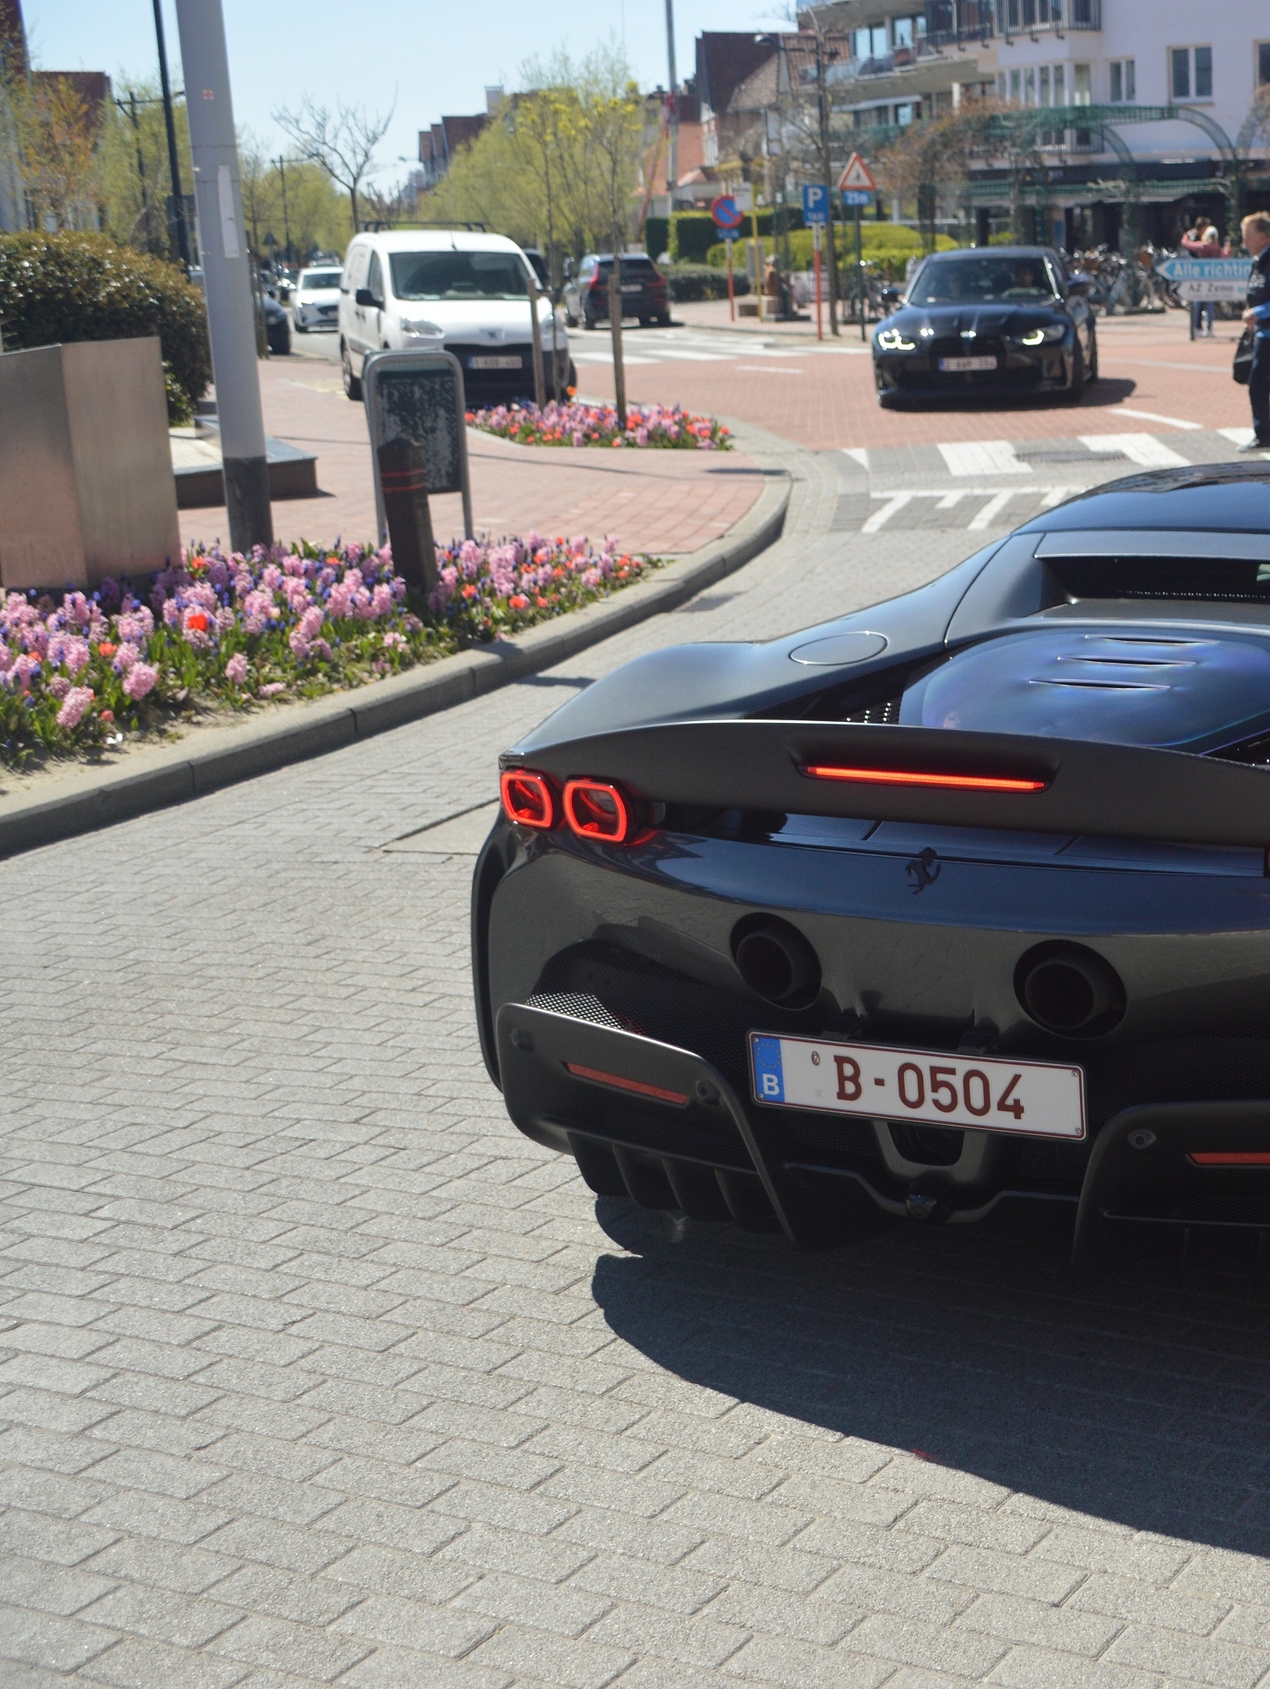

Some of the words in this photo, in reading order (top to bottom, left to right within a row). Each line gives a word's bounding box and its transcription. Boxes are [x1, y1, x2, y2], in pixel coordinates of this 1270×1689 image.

[808, 187, 823, 208] P
[846, 193, 869, 205] 25m
[1173, 262, 1202, 277] Alle
[762, 1074, 780, 1096] B
[833, 1054, 1025, 1120] B-0504
